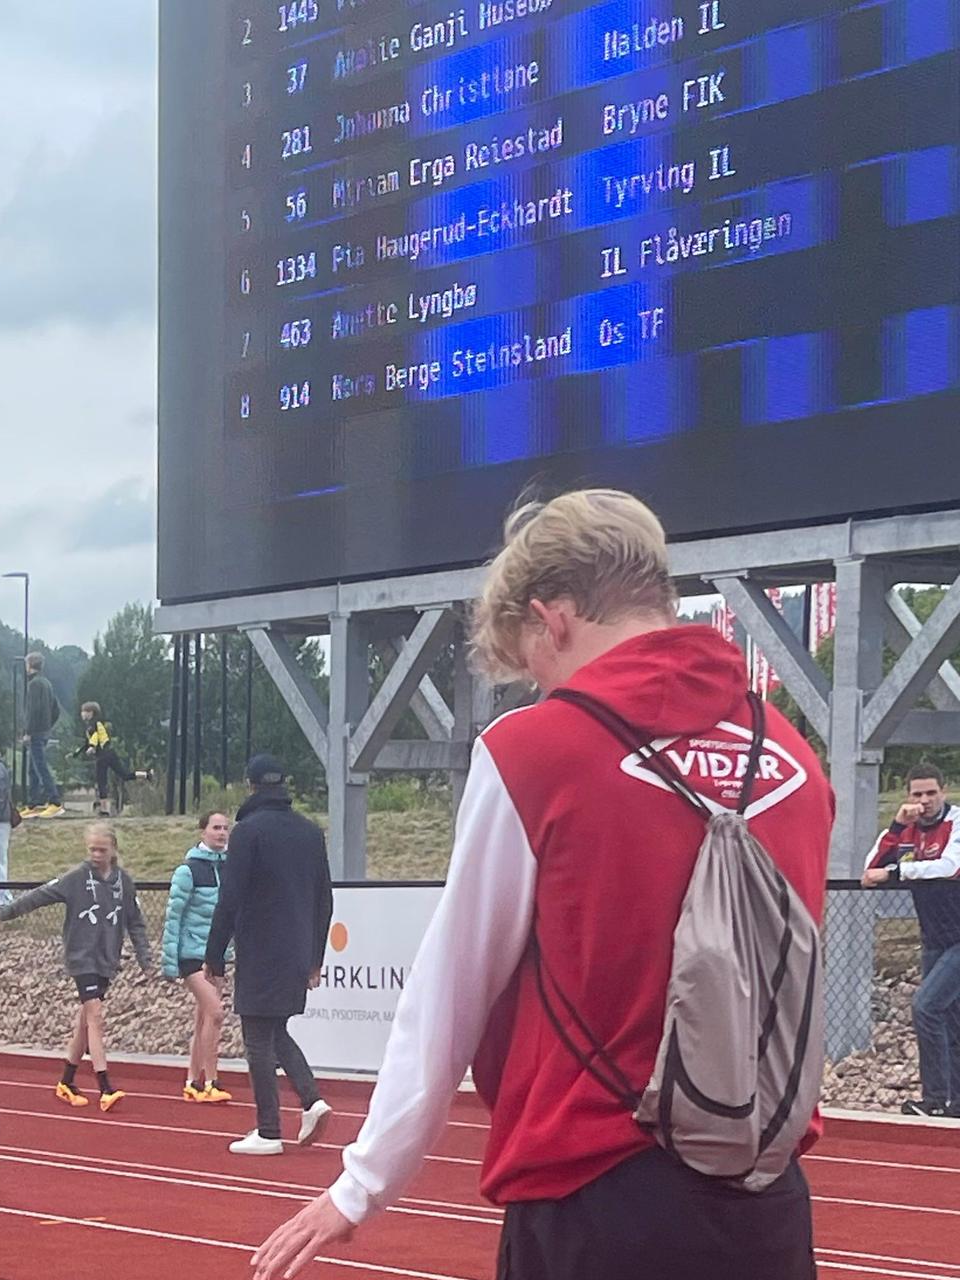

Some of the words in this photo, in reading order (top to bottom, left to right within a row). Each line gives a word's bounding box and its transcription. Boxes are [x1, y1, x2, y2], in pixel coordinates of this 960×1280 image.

[242, 19, 252, 45] 2
[278, 0, 319, 32] 1445
[604, 17, 684, 60] Halden
[698, 1, 726, 34] IL
[242, 83, 252, 107] 3
[287, 63, 308, 94] 37
[411, 10, 468, 51] Ganji
[603, 94, 668, 134] Bryne
[683, 71, 725, 111] FIK
[242, 145, 252, 169] 4
[281, 126, 312, 159] 281
[286, 192, 307, 220] 56
[409, 155, 455, 186] Erga
[465, 117, 564, 171] Reiestad
[602, 162, 695, 208] Tyrving
[709, 147, 736, 180] IL
[276, 252, 316, 286] 1334
[332, 243, 364, 273] Pia
[376, 188, 573, 262] Haugerud-Eckhardt
[600, 247, 627, 278] IL
[641, 213, 791, 268] Flåværingen
[280, 319, 311, 347] 463
[408, 282, 477, 322] Lyngbø
[599, 318, 625, 346] Os
[638, 307, 664, 340] TF
[241, 393, 250, 418] 8
[280, 381, 311, 410] 914
[385, 360, 441, 391] Berge
[452, 327, 571, 377] Steinsland
